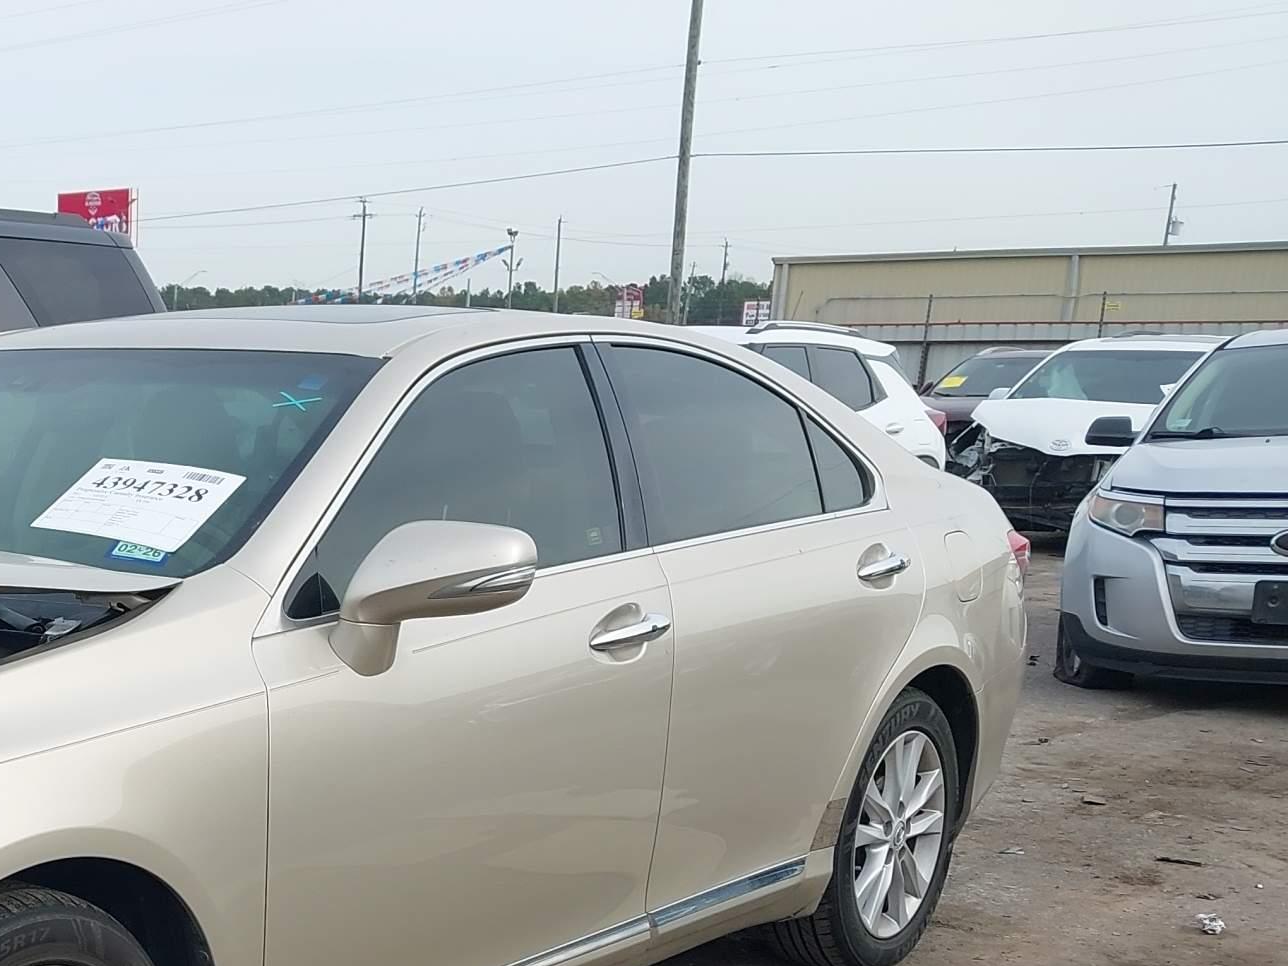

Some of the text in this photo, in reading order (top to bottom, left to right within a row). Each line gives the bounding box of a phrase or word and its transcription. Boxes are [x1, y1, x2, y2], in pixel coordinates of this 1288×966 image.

[92, 475, 209, 503] 43947328
[118, 543, 162, 558] 02 26
